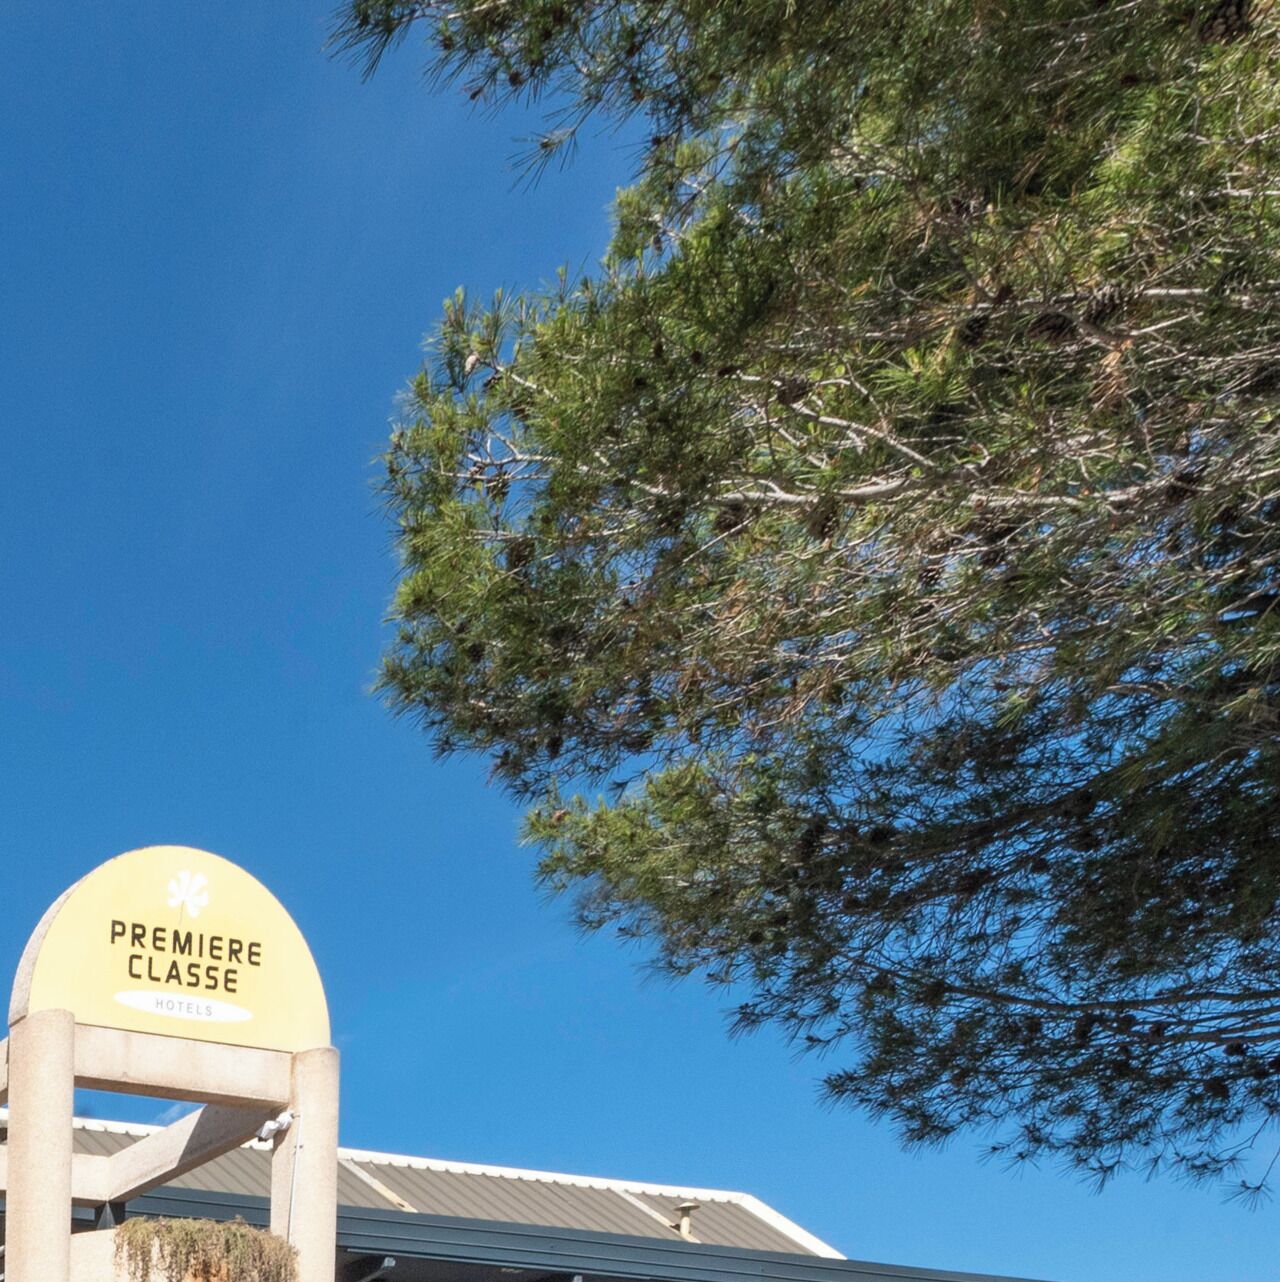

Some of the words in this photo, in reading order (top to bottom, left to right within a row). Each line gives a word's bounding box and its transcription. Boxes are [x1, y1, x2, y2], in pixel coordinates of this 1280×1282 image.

[110, 919, 261, 967] PREMIERE
[128, 953, 238, 993] CLASSE
[155, 998, 213, 1017] HOTELS
